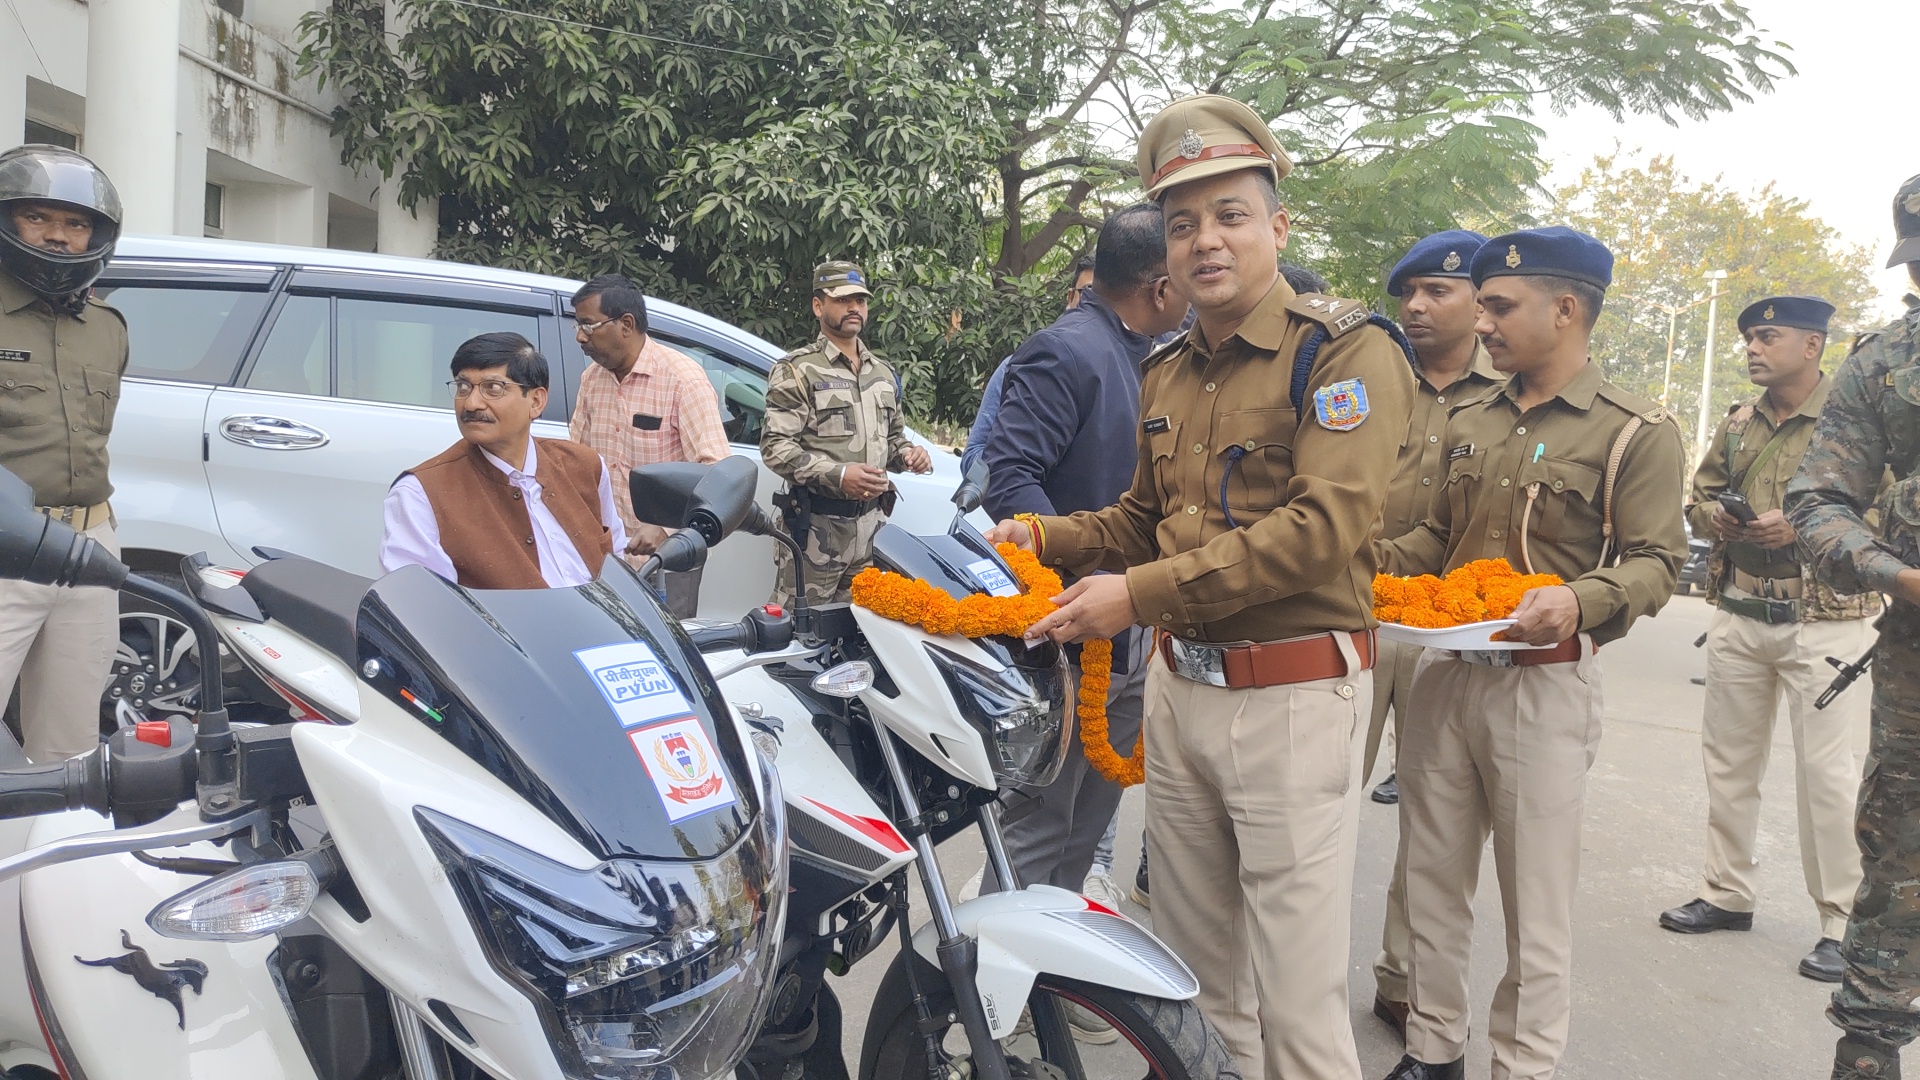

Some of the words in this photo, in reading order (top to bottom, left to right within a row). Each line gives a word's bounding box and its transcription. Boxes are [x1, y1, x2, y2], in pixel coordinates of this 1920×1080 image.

[989, 578, 1009, 588] PVUN
[604, 667, 659, 682] पीवीयुएन
[616, 680, 668, 699] PVUN
[983, 994, 999, 1031] ABS
